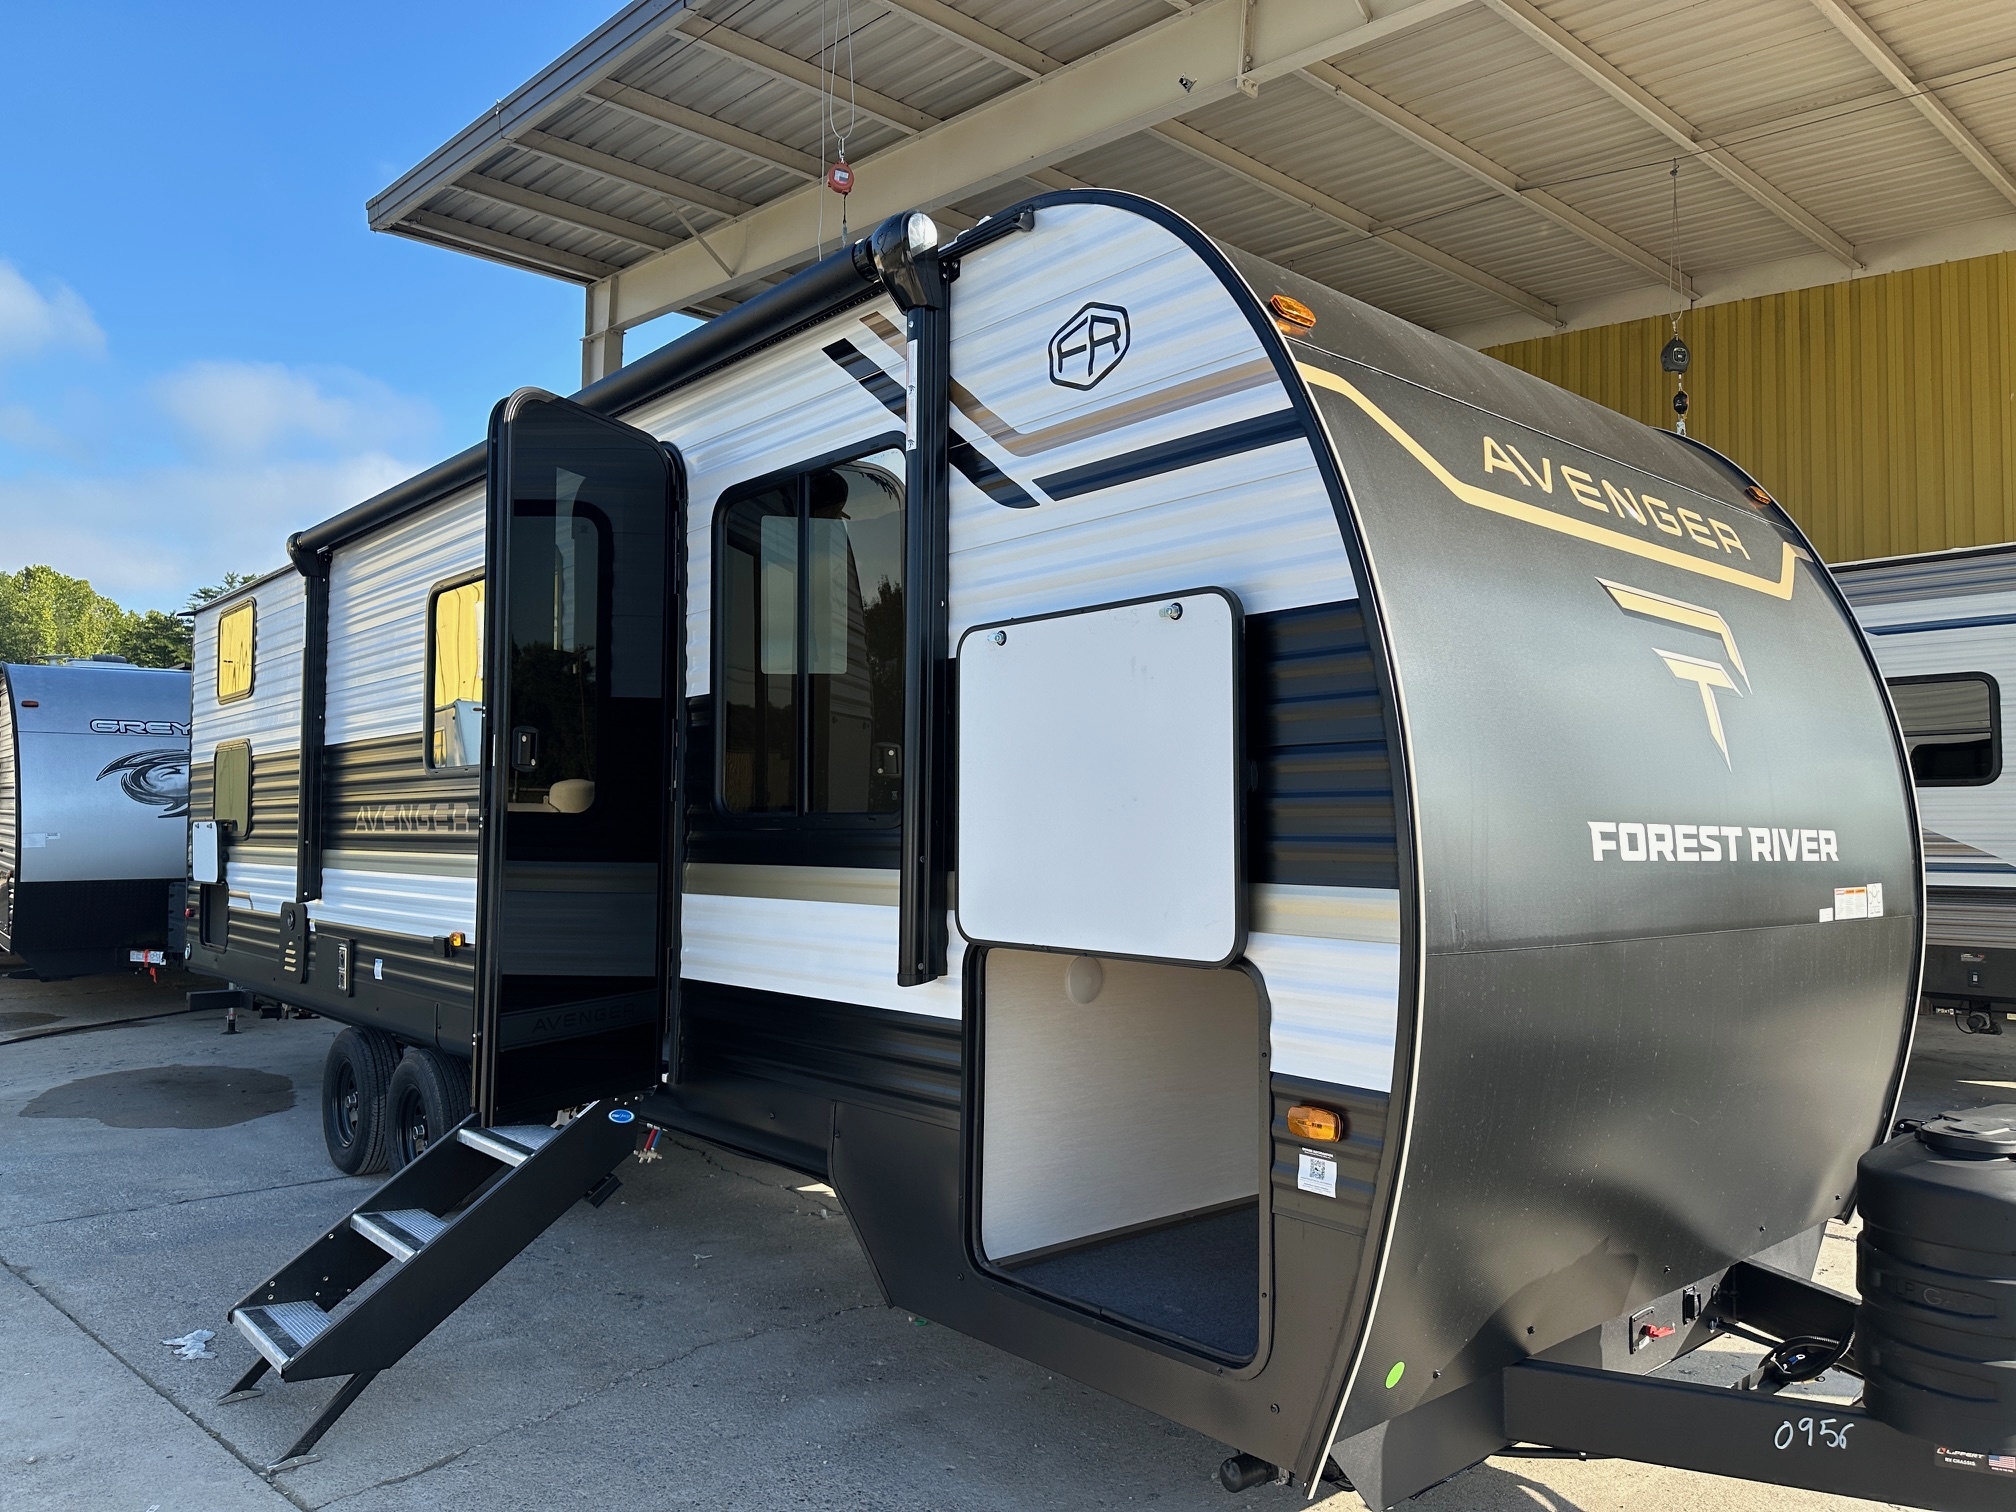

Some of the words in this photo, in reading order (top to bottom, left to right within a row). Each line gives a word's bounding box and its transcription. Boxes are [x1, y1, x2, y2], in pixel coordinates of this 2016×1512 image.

[1483, 436, 1751, 560] AVENGER
[90, 719, 190, 736] GREY
[354, 803, 470, 832] AVENGER
[1587, 821, 1743, 862] FOREST
[1748, 827, 1840, 862] RIVER
[532, 1002, 635, 1033] AVENGER
[1896, 1279, 1915, 1296] LP
[1774, 1417, 1855, 1450] 0956
